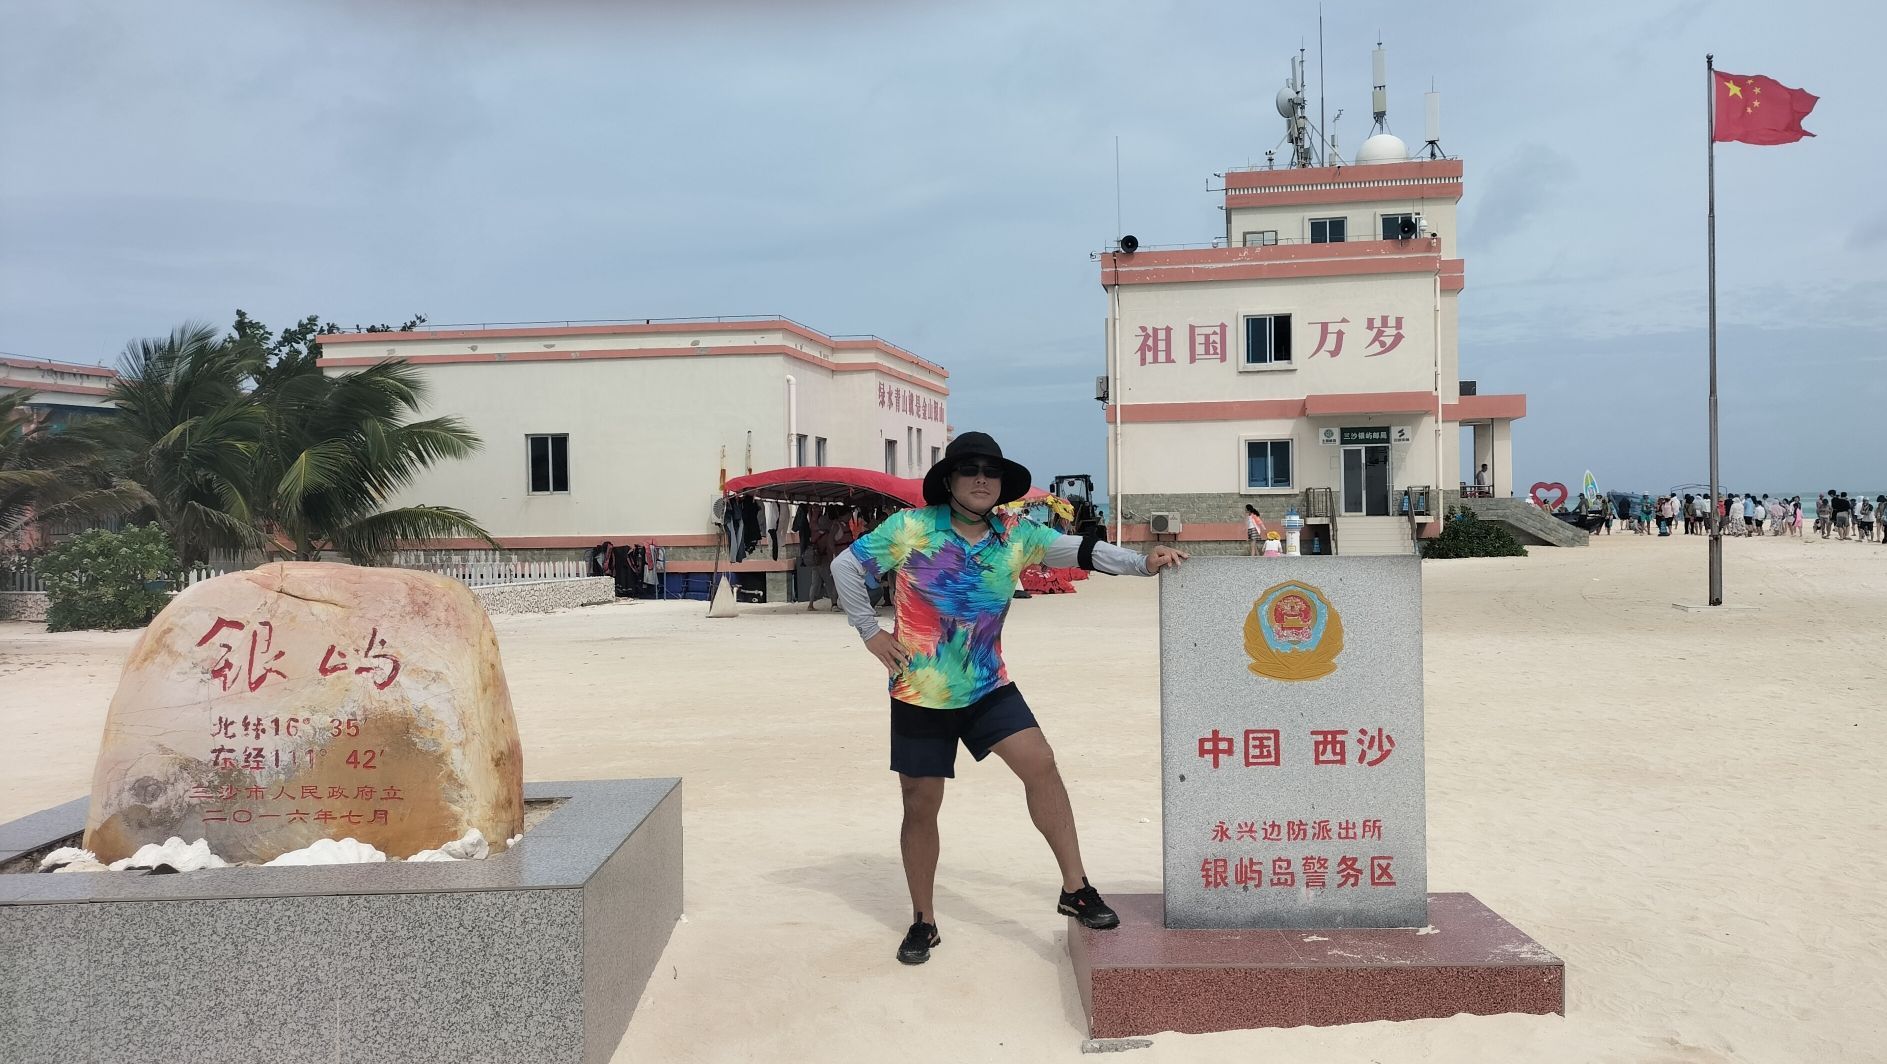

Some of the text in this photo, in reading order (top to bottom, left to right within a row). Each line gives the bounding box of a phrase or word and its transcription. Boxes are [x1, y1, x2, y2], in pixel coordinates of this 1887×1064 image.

[1134, 315, 1406, 367] 祖国 万岁
[1343, 431, 1388, 441] 三沙银屿邮局
[195, 616, 402, 692] 银屿
[1198, 727, 1396, 769] 中国 西沙
[188, 784, 405, 801] 三沙市人民政府立
[1210, 819, 1383, 843] 永兴边防派出所
[1200, 855, 1397, 889] 银屿岛警务区
